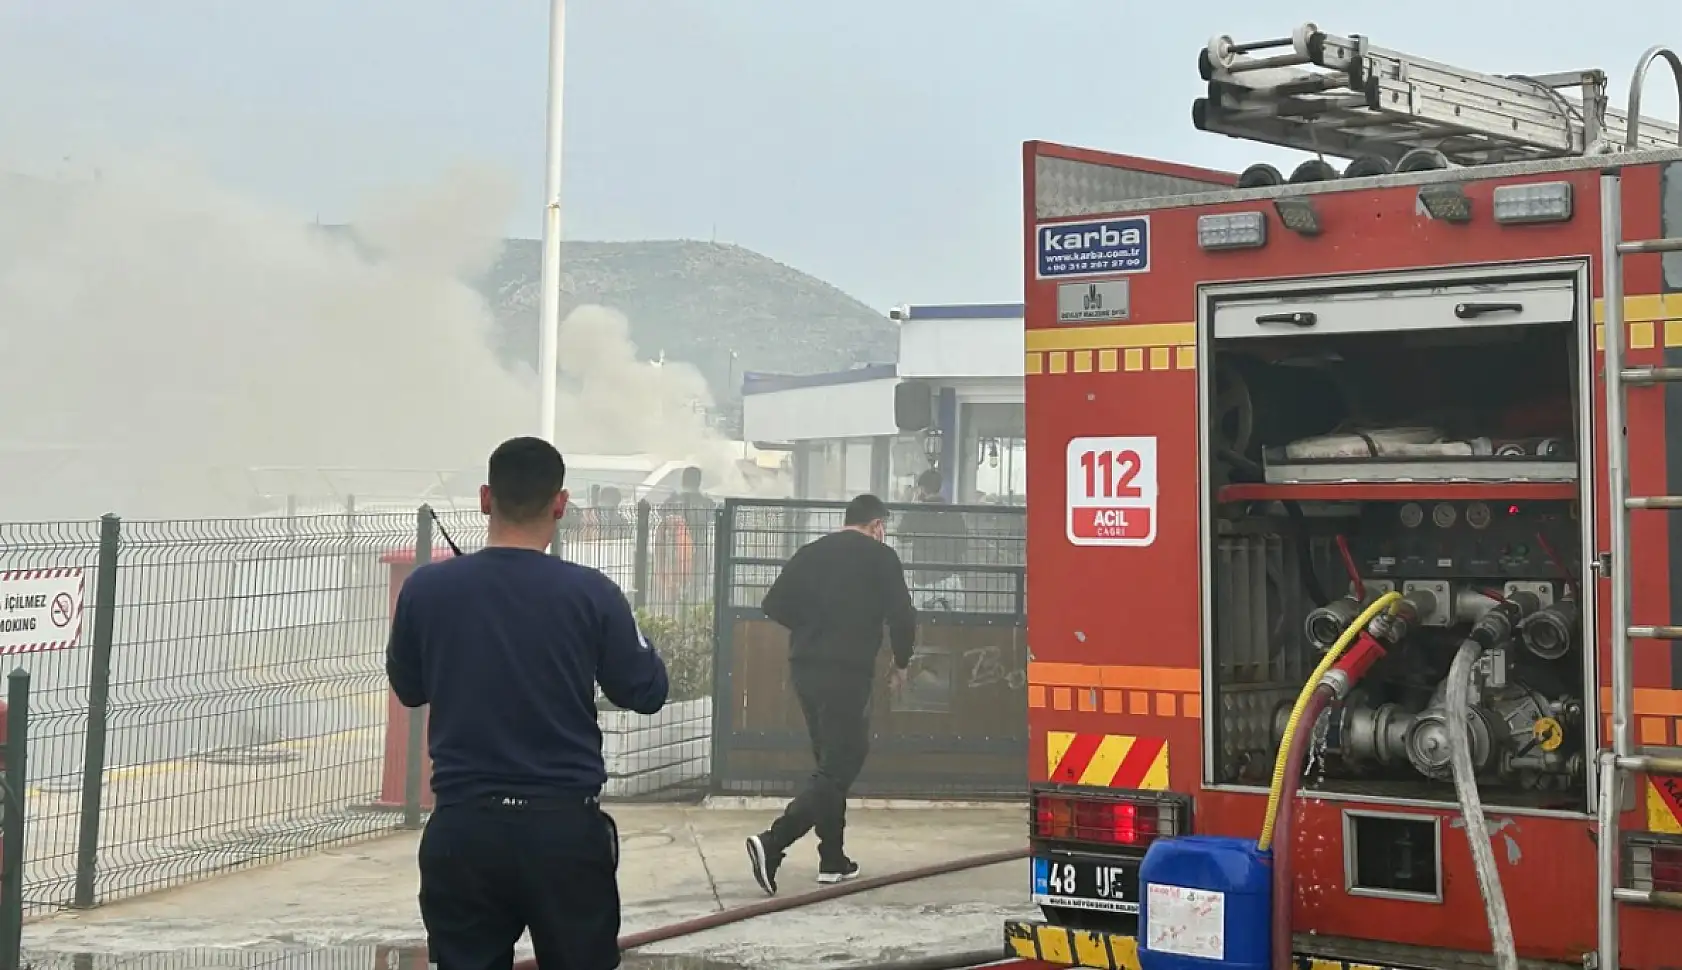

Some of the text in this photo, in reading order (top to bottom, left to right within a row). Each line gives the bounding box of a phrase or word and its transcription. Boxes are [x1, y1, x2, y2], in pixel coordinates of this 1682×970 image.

[1045, 225, 1140, 251] karba
[1045, 248, 1140, 262] www.karba.com.tr
[1081, 450, 1142, 498] 112
[5, 593, 47, 612] İÇİLMEZ
[1050, 863, 1076, 893] 48
[1096, 866, 1123, 899] UE
